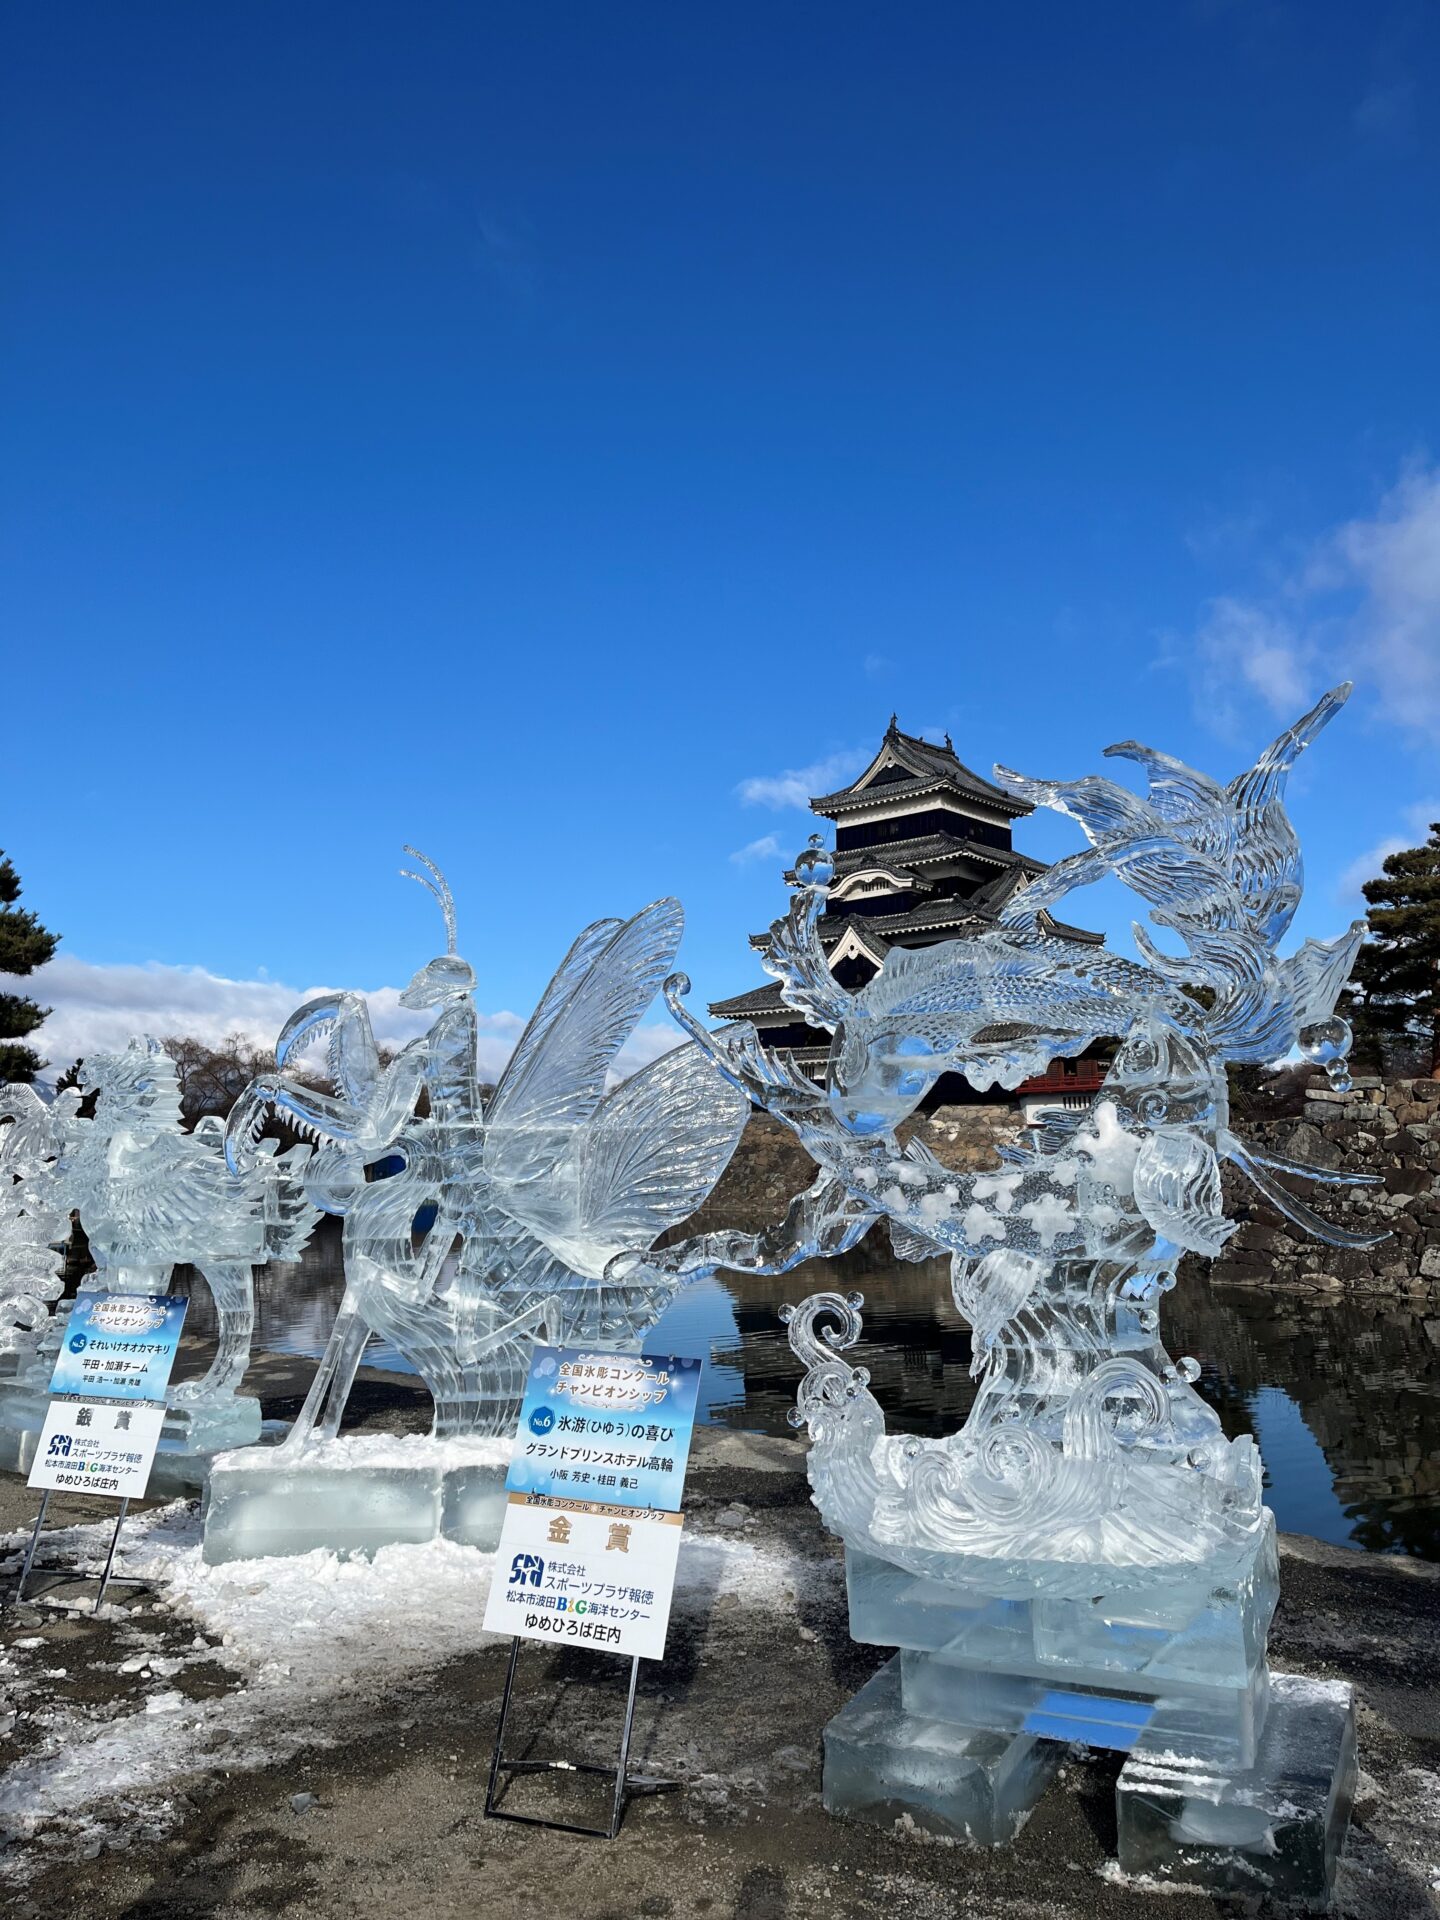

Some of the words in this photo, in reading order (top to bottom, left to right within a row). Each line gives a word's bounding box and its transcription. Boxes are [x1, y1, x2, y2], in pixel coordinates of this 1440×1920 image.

[89, 1316, 163, 1328] チャンピオンシップ
[89, 1339, 170, 1355] それいけオオカマキリ
[559, 1362, 670, 1385] 全国氷彫コンクール
[556, 1381, 667, 1404] チャンピオンシップ
[533, 1416, 551, 1428] No.6
[74, 1438, 100, 1448] 株式会社
[71, 1448, 143, 1464] スポーツプラザ報徳
[526, 1442, 674, 1472] グランドプリンスホテル高輪
[55, 1473, 119, 1490] ゆめひろば庄内
[547, 1561, 586, 1577] 株式会社
[545, 1576, 655, 1605] スポーツプラザ報徳
[524, 1613, 622, 1644] ゆめひろば庄内
